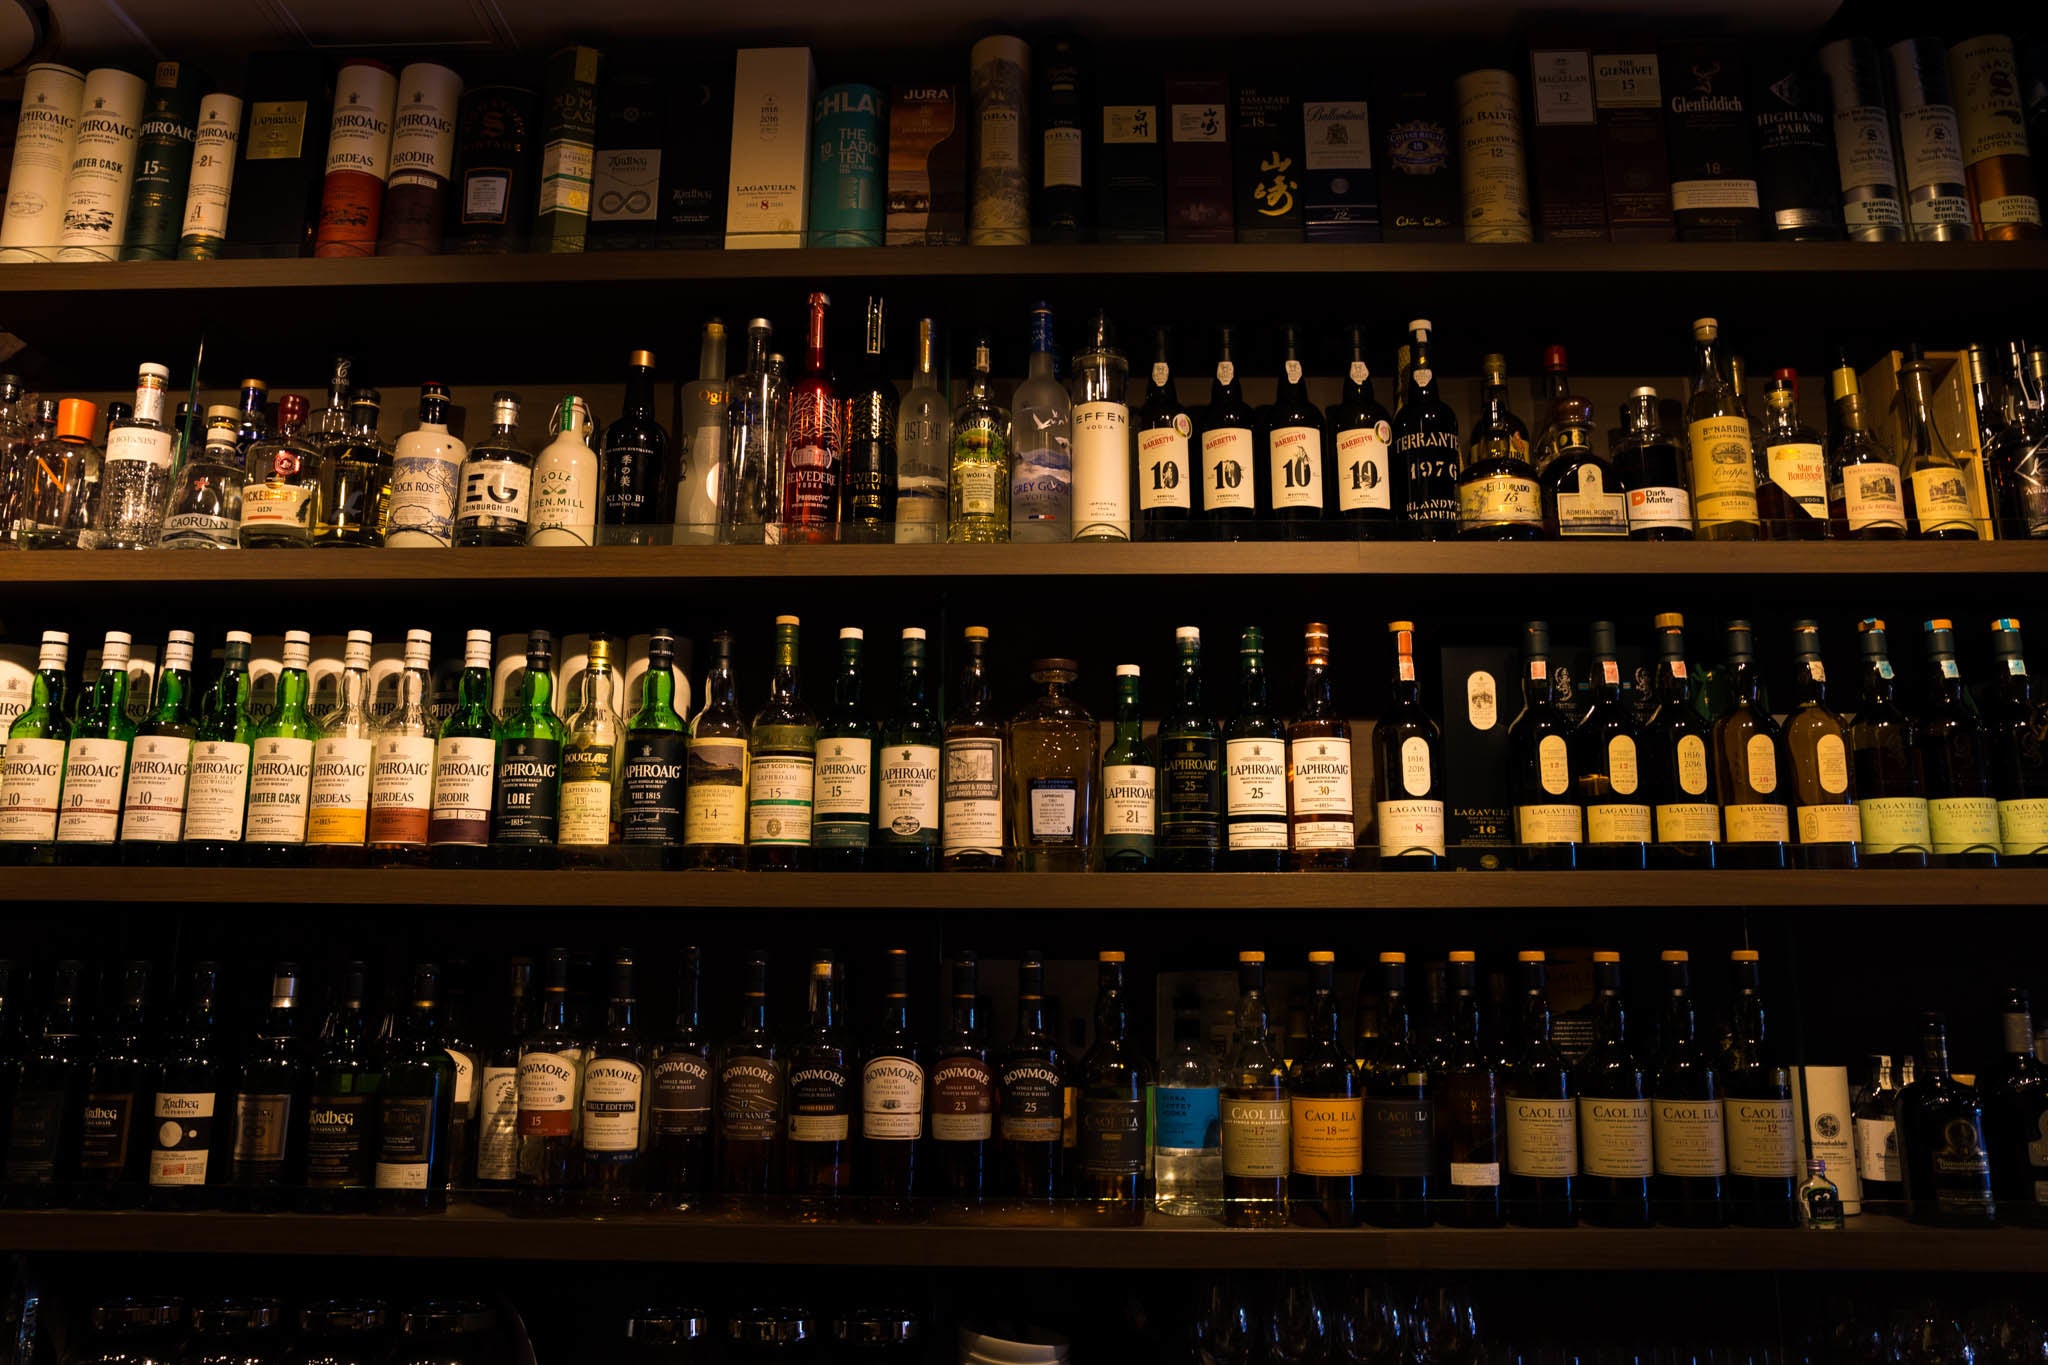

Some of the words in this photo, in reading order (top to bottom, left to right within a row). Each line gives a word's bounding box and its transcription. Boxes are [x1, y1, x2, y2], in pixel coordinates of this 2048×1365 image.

[1600, 67, 1652, 77] GLENLIVET
[904, 88, 949, 100] JURA
[1672, 96, 1743, 113] Glenfiddich
[19, 111, 74, 129] PHROAIG
[984, 111, 1017, 121] OBAN
[1756, 112, 1824, 125] HIGHLAND
[79, 119, 137, 140] PHROAIG
[332, 113, 387, 134] PHROAIG
[839, 127, 865, 140] THE
[200, 155, 214, 167] 21
[839, 151, 865, 163] TEN
[99, 159, 123, 174] CASK
[144, 160, 160, 174] 15
[1704, 162, 1721, 175] 18
[736, 184, 796, 193] LAGAVULIN
[1254, 150, 1298, 217] 山崎
[761, 199, 769, 209] 8
[1076, 412, 1125, 424] EFFEN
[34, 457, 67, 494] N
[540, 471, 572, 484] GOLF
[787, 470, 837, 486] BELVEDERE
[1151, 460, 1179, 490] 10
[1213, 459, 1241, 490] 10
[1283, 458, 1311, 488] 10
[1349, 460, 1378, 490] 10
[415, 486, 440, 497] ROSE
[1013, 482, 1035, 496] GREY
[1646, 489, 1665, 499] Dark
[618, 494, 632, 502] NO
[635, 494, 645, 503] BI
[1503, 493, 1518, 503] 15
[1646, 496, 1673, 505] Matter
[505, 505, 519, 514] GIN
[1566, 509, 1594, 517] ADMIRAL
[1594, 509, 1618, 517] RODNEY
[171, 514, 229, 529] CAORUNN
[67, 764, 120, 778] PHROAIG
[314, 763, 365, 777] PHROAIG
[817, 764, 866, 776] LAPHROAIG
[1164, 760, 1217, 771] LAPHROAIG
[1231, 765, 1283, 776] LAPHROAIG
[1296, 764, 1348, 776] LAPHROAIG
[881, 768, 936, 782] LAPHROAIG
[832, 786, 842, 797] 15
[1185, 781, 1196, 791] 25
[1319, 786, 1330, 796] 30
[139, 791, 152, 805] 10
[279, 793, 301, 804] CASK
[770, 788, 782, 798] 15
[899, 788, 912, 797] 18
[1252, 788, 1263, 799] 25
[8, 792, 20, 806] 10
[71, 794, 83, 807] 10
[507, 793, 532, 805] LORE
[705, 808, 718, 819] 14
[1127, 810, 1138, 822] 21
[1415, 824, 1423, 833] 8
[1479, 826, 1496, 834] 16
[1003, 1067, 1061, 1087] BOWMORE
[953, 1101, 967, 1112] 23
[1024, 1101, 1038, 1113] 25
[1518, 1105, 1552, 1119] CAOL
[1558, 1107, 1574, 1118] ILA
[1593, 1105, 1629, 1119] CAOL
[1663, 1106, 1699, 1119] CAOL
[1703, 1106, 1720, 1118] ILA
[1740, 1106, 1777, 1119] CAOL
[1231, 1106, 1267, 1120] CAOL
[1270, 1109, 1286, 1120] ILA
[1304, 1109, 1338, 1122] CAOL
[1341, 1110, 1357, 1122] ILA
[532, 1115, 542, 1127] 15
[1254, 1125, 1265, 1136] 17
[1326, 1125, 1337, 1137] 18
[1767, 1123, 1778, 1136] 12
